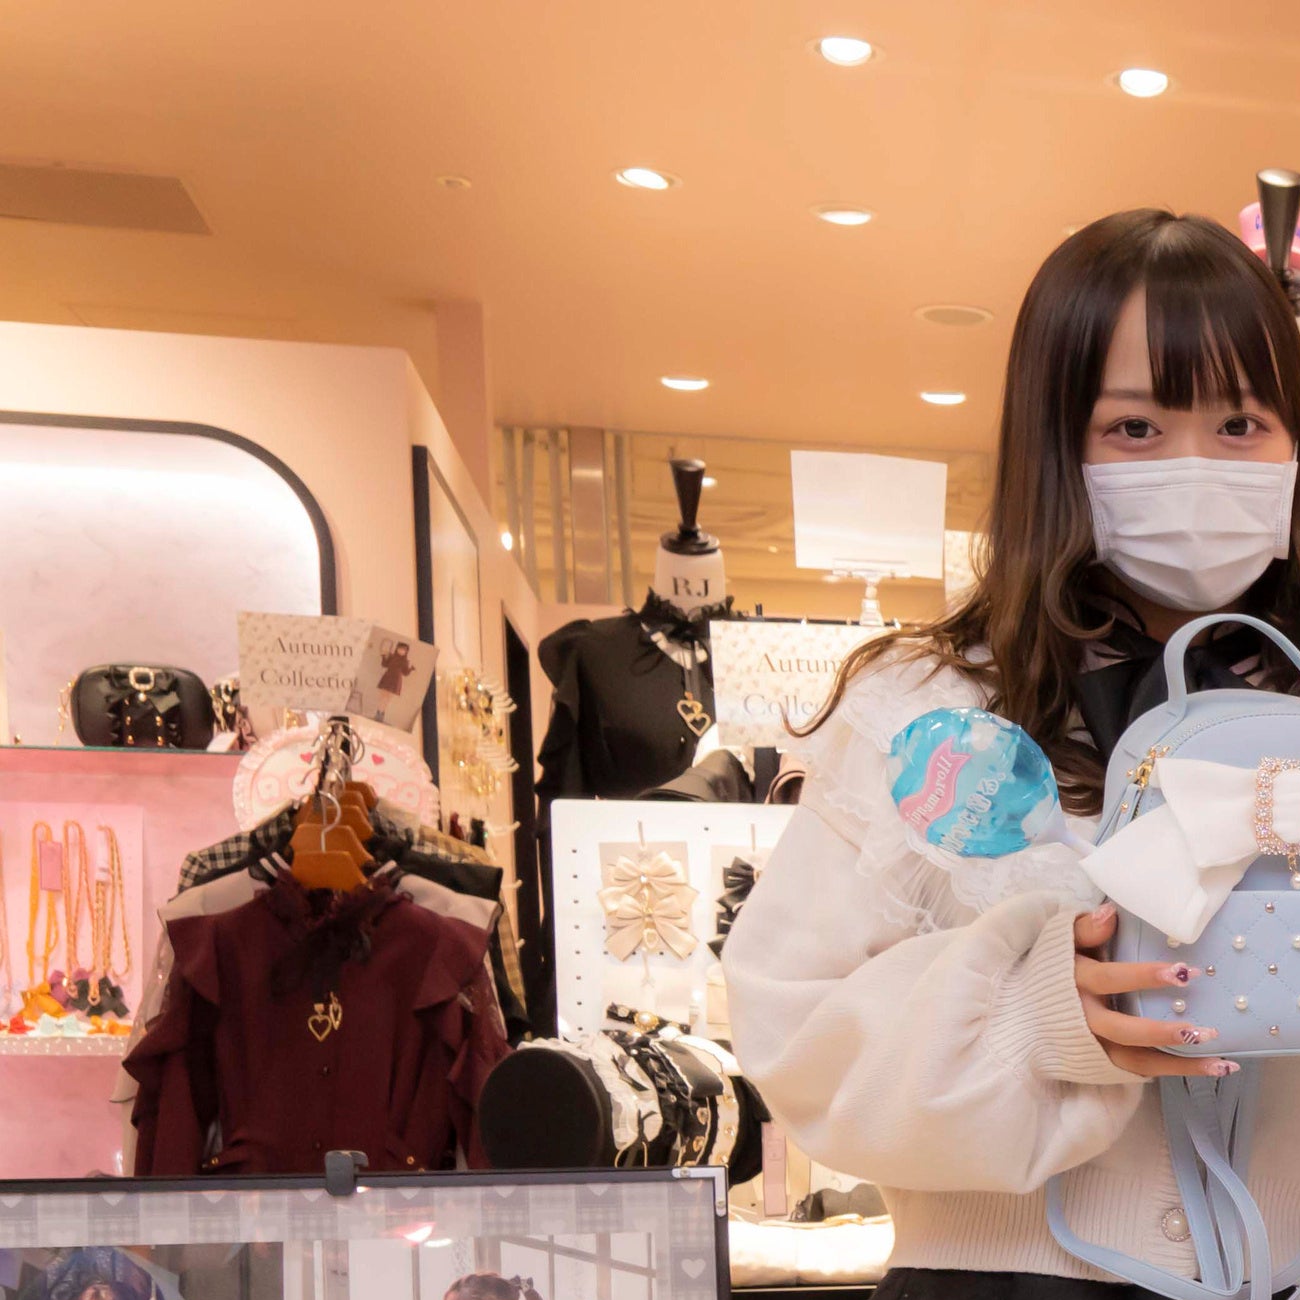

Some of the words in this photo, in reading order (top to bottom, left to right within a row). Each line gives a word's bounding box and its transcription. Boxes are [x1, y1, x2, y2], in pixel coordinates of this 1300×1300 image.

[272, 636, 354, 658] Autumn
[757, 652, 844, 673] Autum
[260, 668, 359, 690] Collectio
